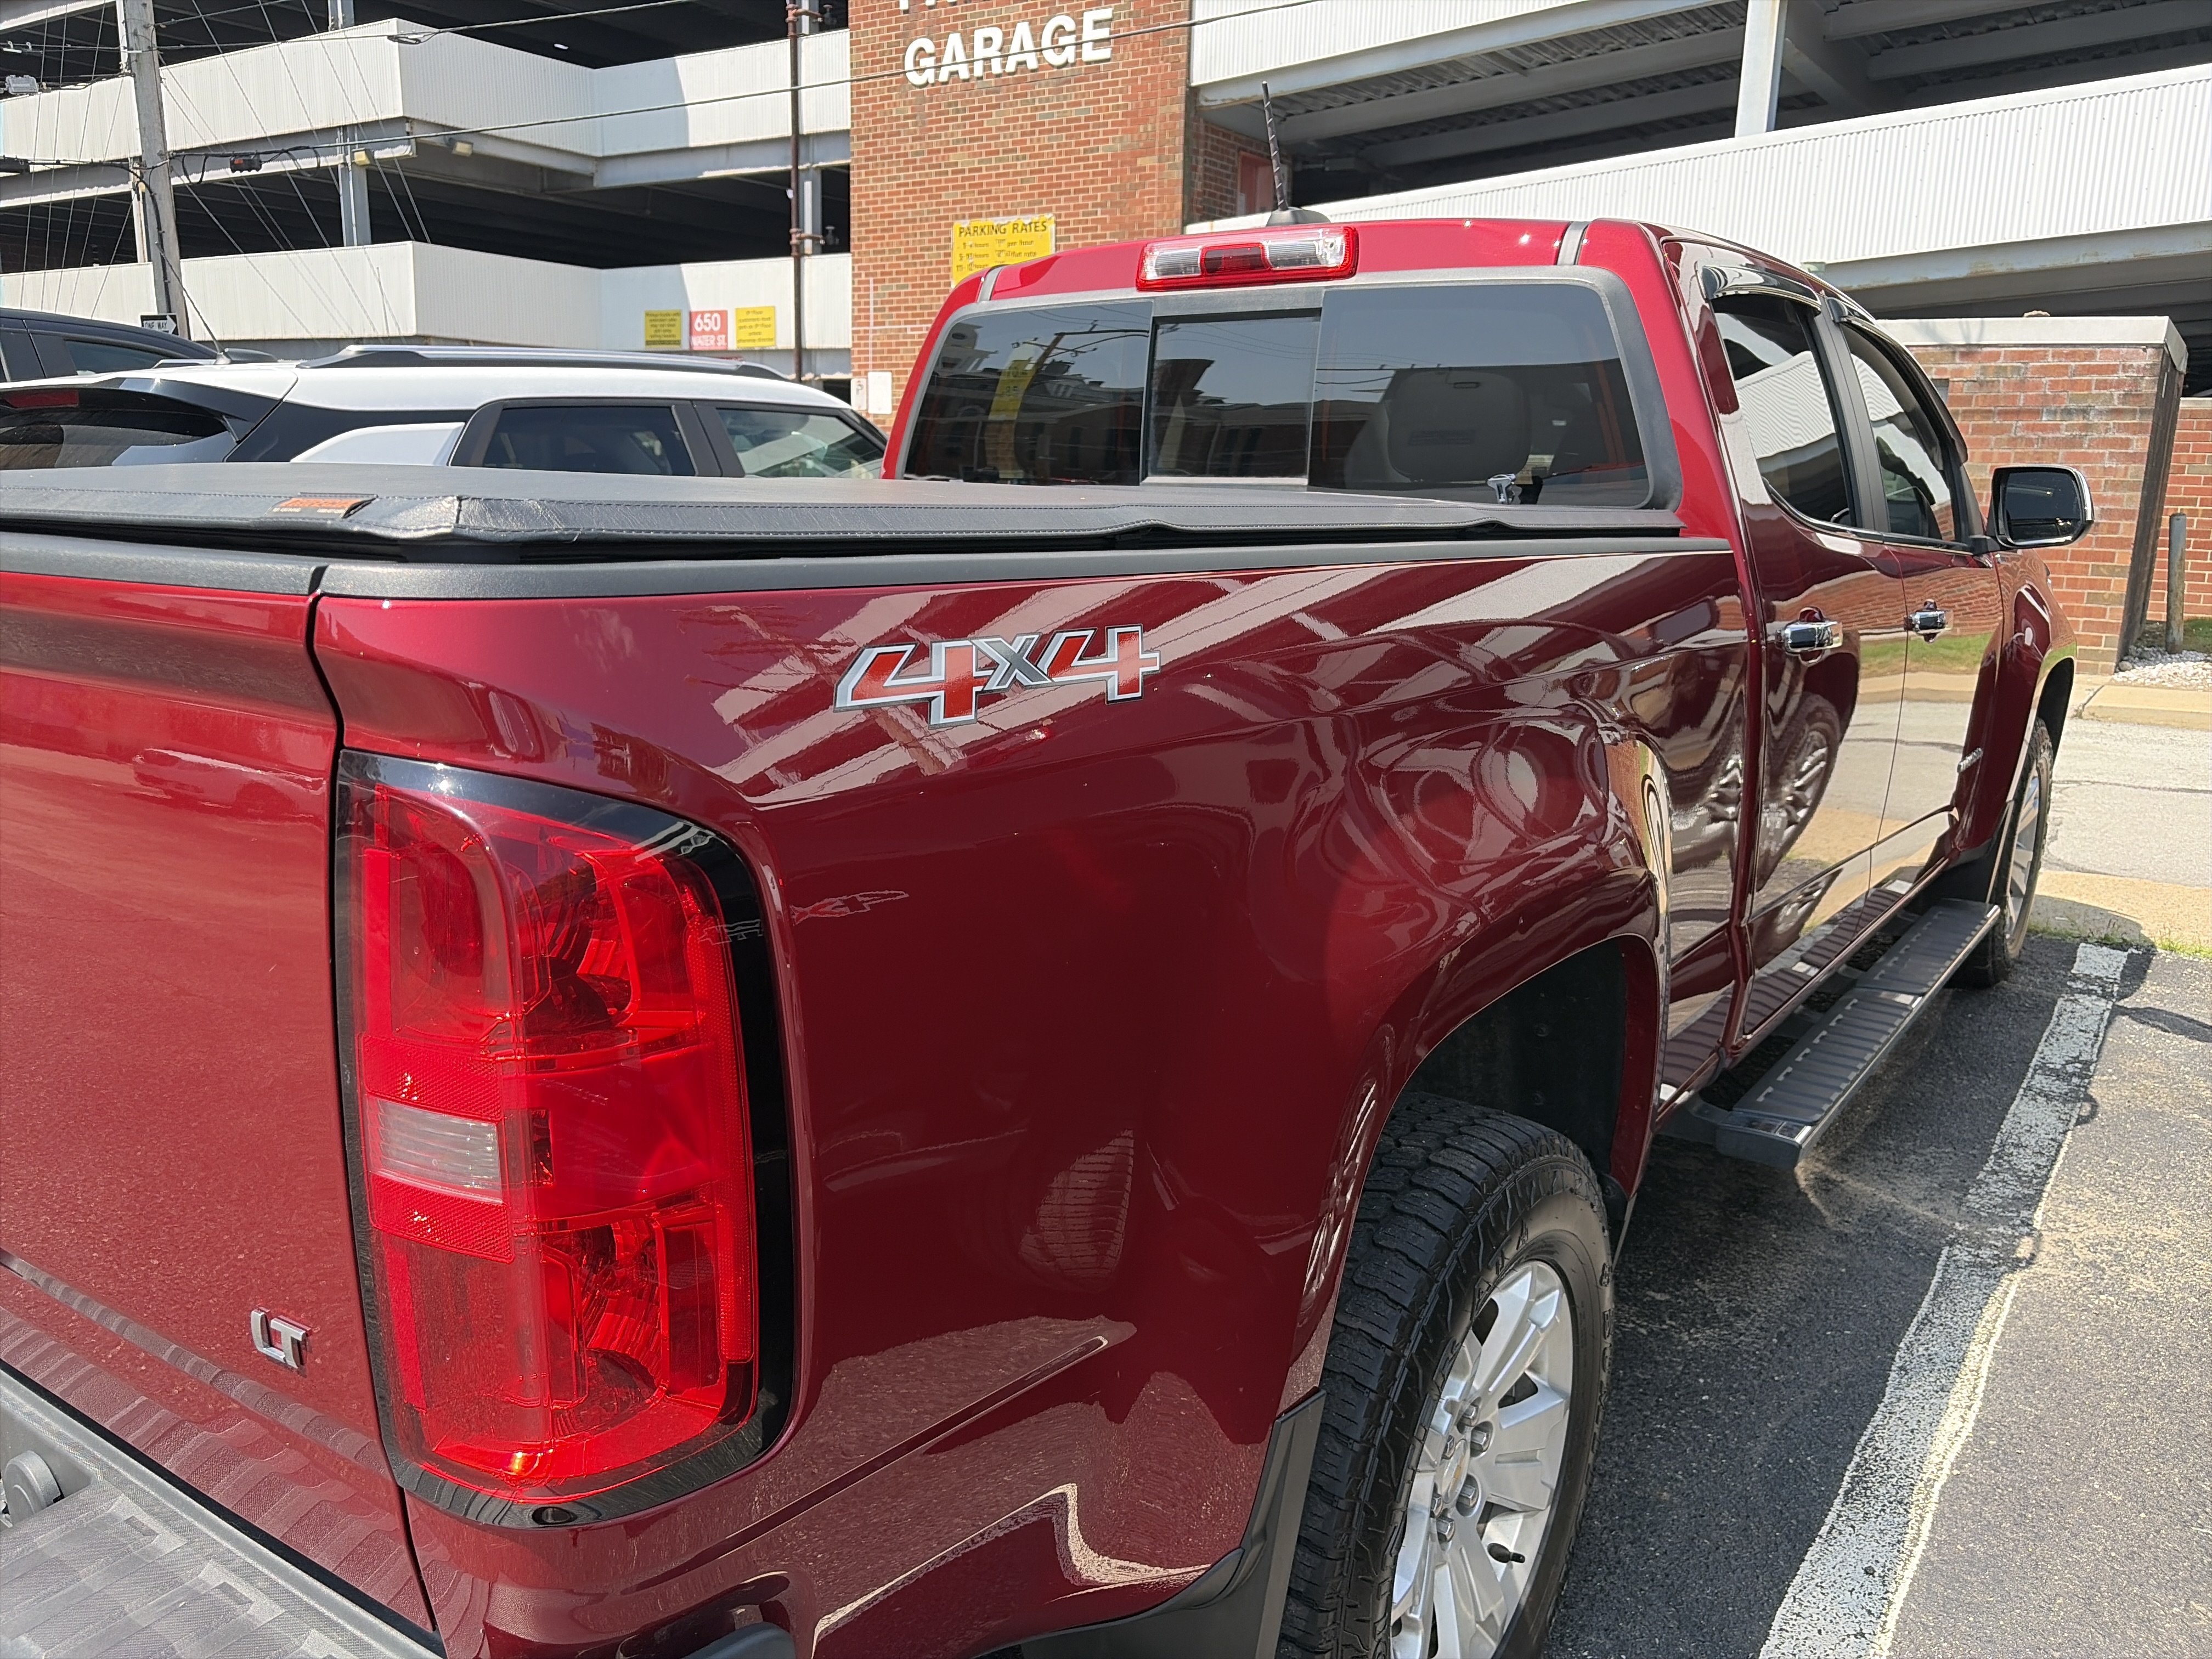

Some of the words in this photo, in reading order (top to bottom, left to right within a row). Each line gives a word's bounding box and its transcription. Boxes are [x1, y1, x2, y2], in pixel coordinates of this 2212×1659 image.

[904, 8, 1113, 86] GARAGE
[958, 223, 1007, 237] PARKING
[1012, 221, 1047, 233] RATES
[694, 313, 721, 332] 650
[251, 1310, 306, 1369] LT
